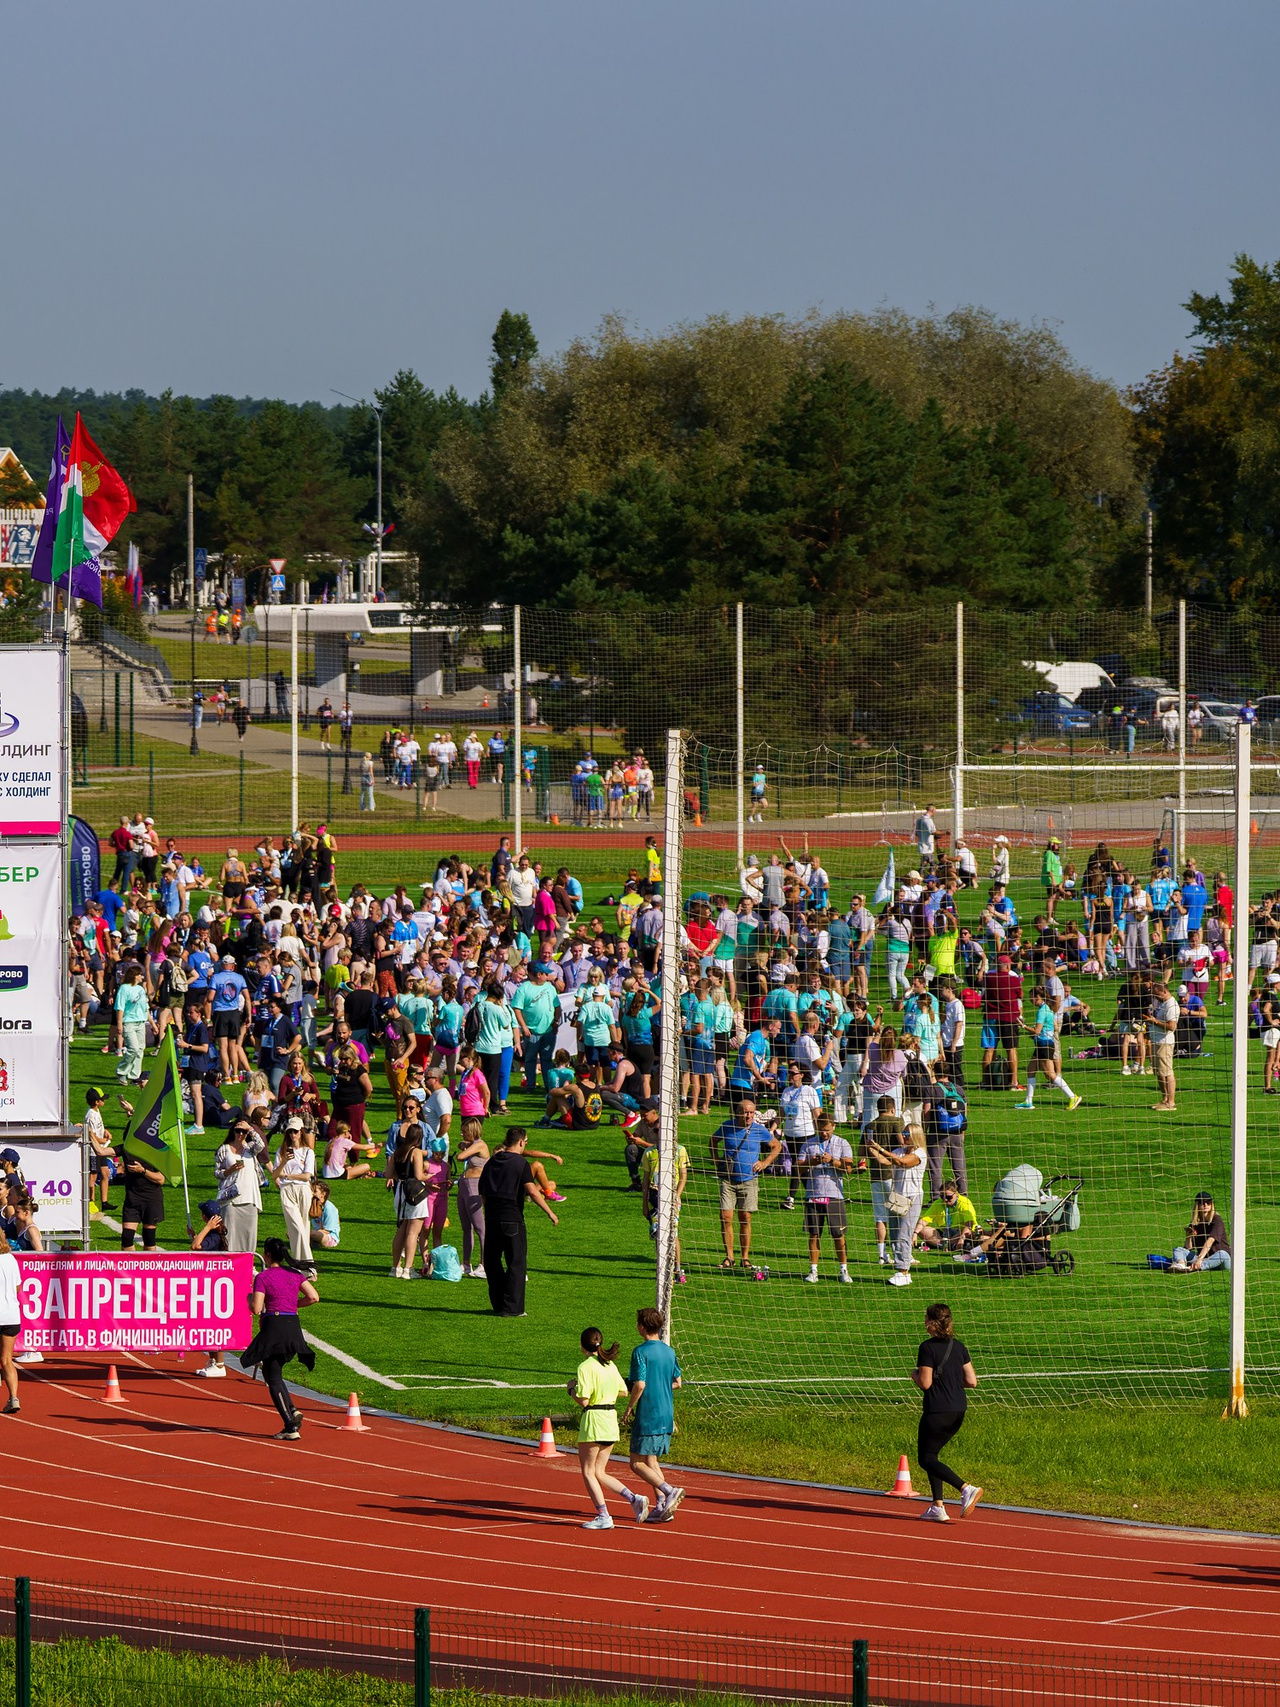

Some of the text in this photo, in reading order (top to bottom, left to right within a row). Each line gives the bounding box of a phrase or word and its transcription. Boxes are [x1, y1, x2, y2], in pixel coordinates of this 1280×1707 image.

[12, 771, 52, 783] СДЕЛАЛ
[5, 786, 52, 798] ХОЛДИНГ
[42, 1180, 72, 1197] 40
[37, 1198, 73, 1206] СПОРТЕ!
[23, 1258, 235, 1272] РОДИТЕЛЯМ И ЛИЦАМ, СОПРОВОЖДАЮЩИМ ДЕТЕЙ,
[22, 1277, 234, 1324] ЗАПРЕЩЕНО
[24, 1326, 232, 1347] ВБЕГАТЬ В ФИНИШНЫЙ СТВОР
